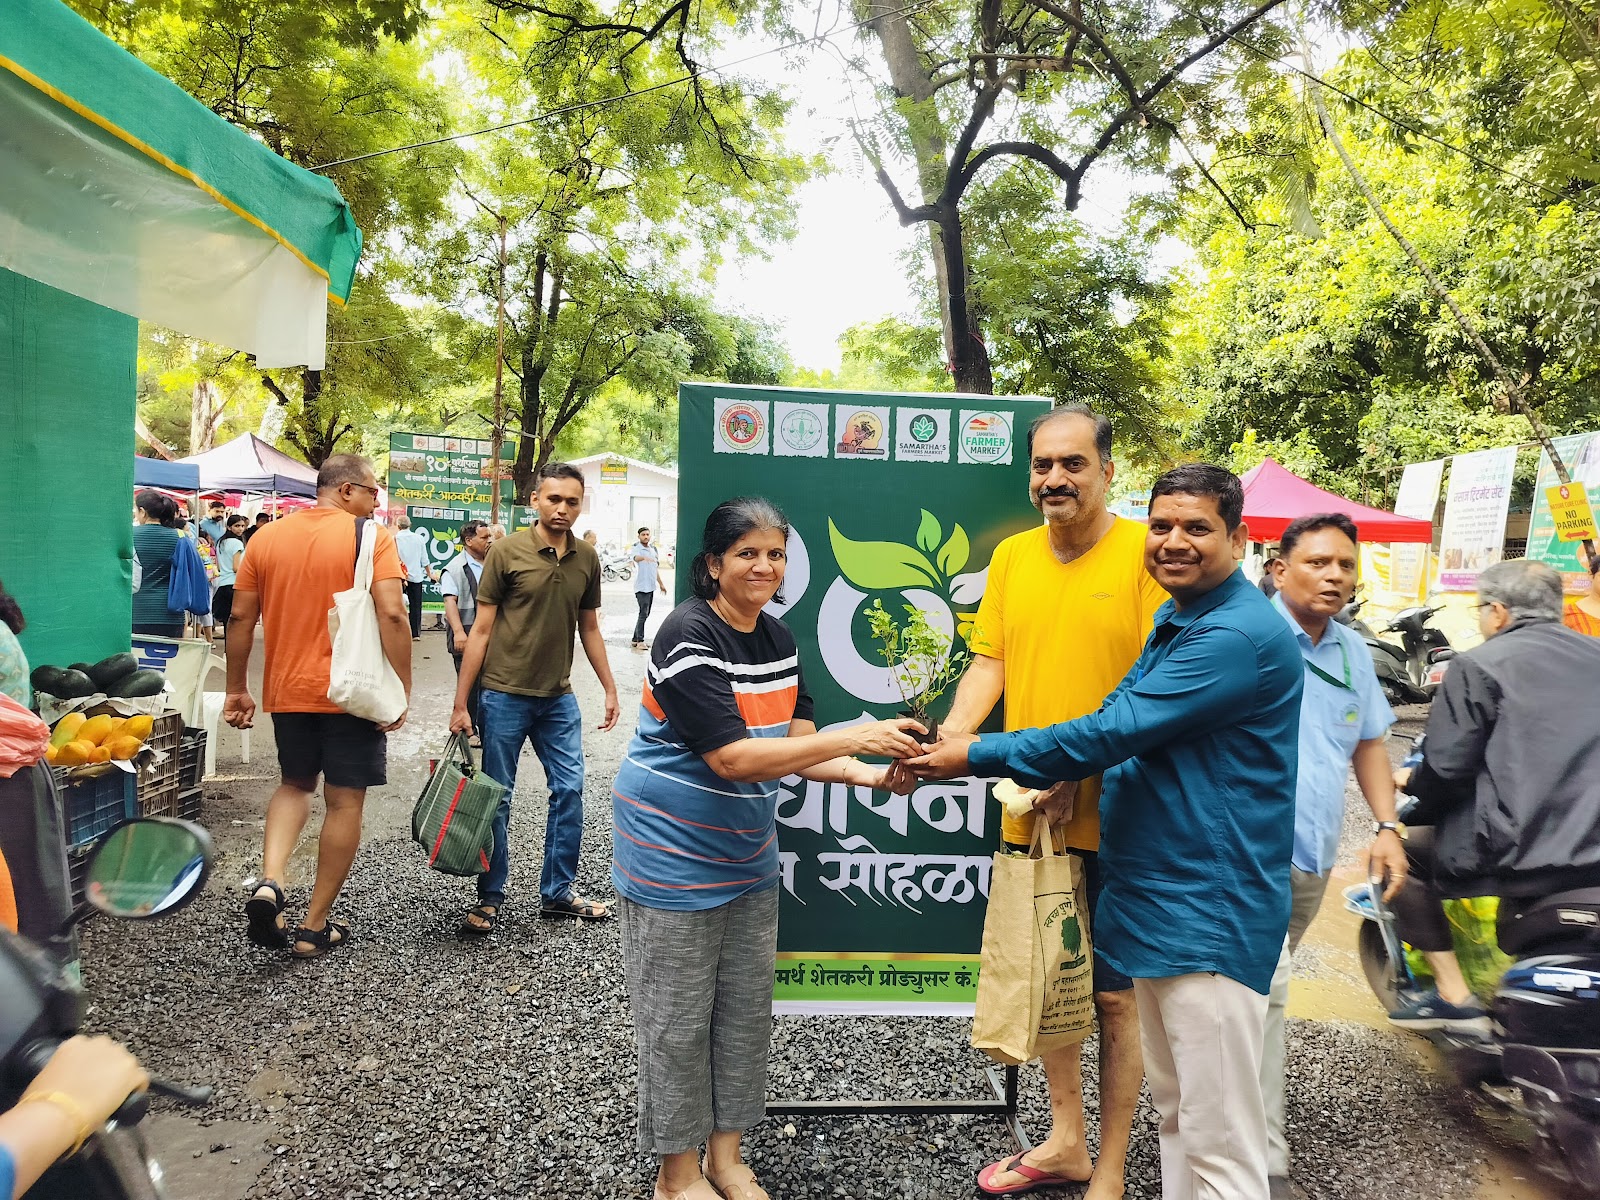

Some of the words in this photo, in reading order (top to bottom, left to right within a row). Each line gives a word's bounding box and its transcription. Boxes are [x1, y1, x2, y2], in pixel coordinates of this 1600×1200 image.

[899, 442, 946, 451] SAMARTHA'S
[965, 436, 1006, 447] FARMER
[970, 446, 1001, 455] MARKET
[1564, 500, 1575, 508] CURE
[1565, 510, 1578, 520] NO
[1557, 518, 1593, 531] PARKING
[774, 963, 805, 986] मर्थ
[810, 963, 874, 987] शेतकरी
[879, 963, 950, 994] प्रोड्युसर
